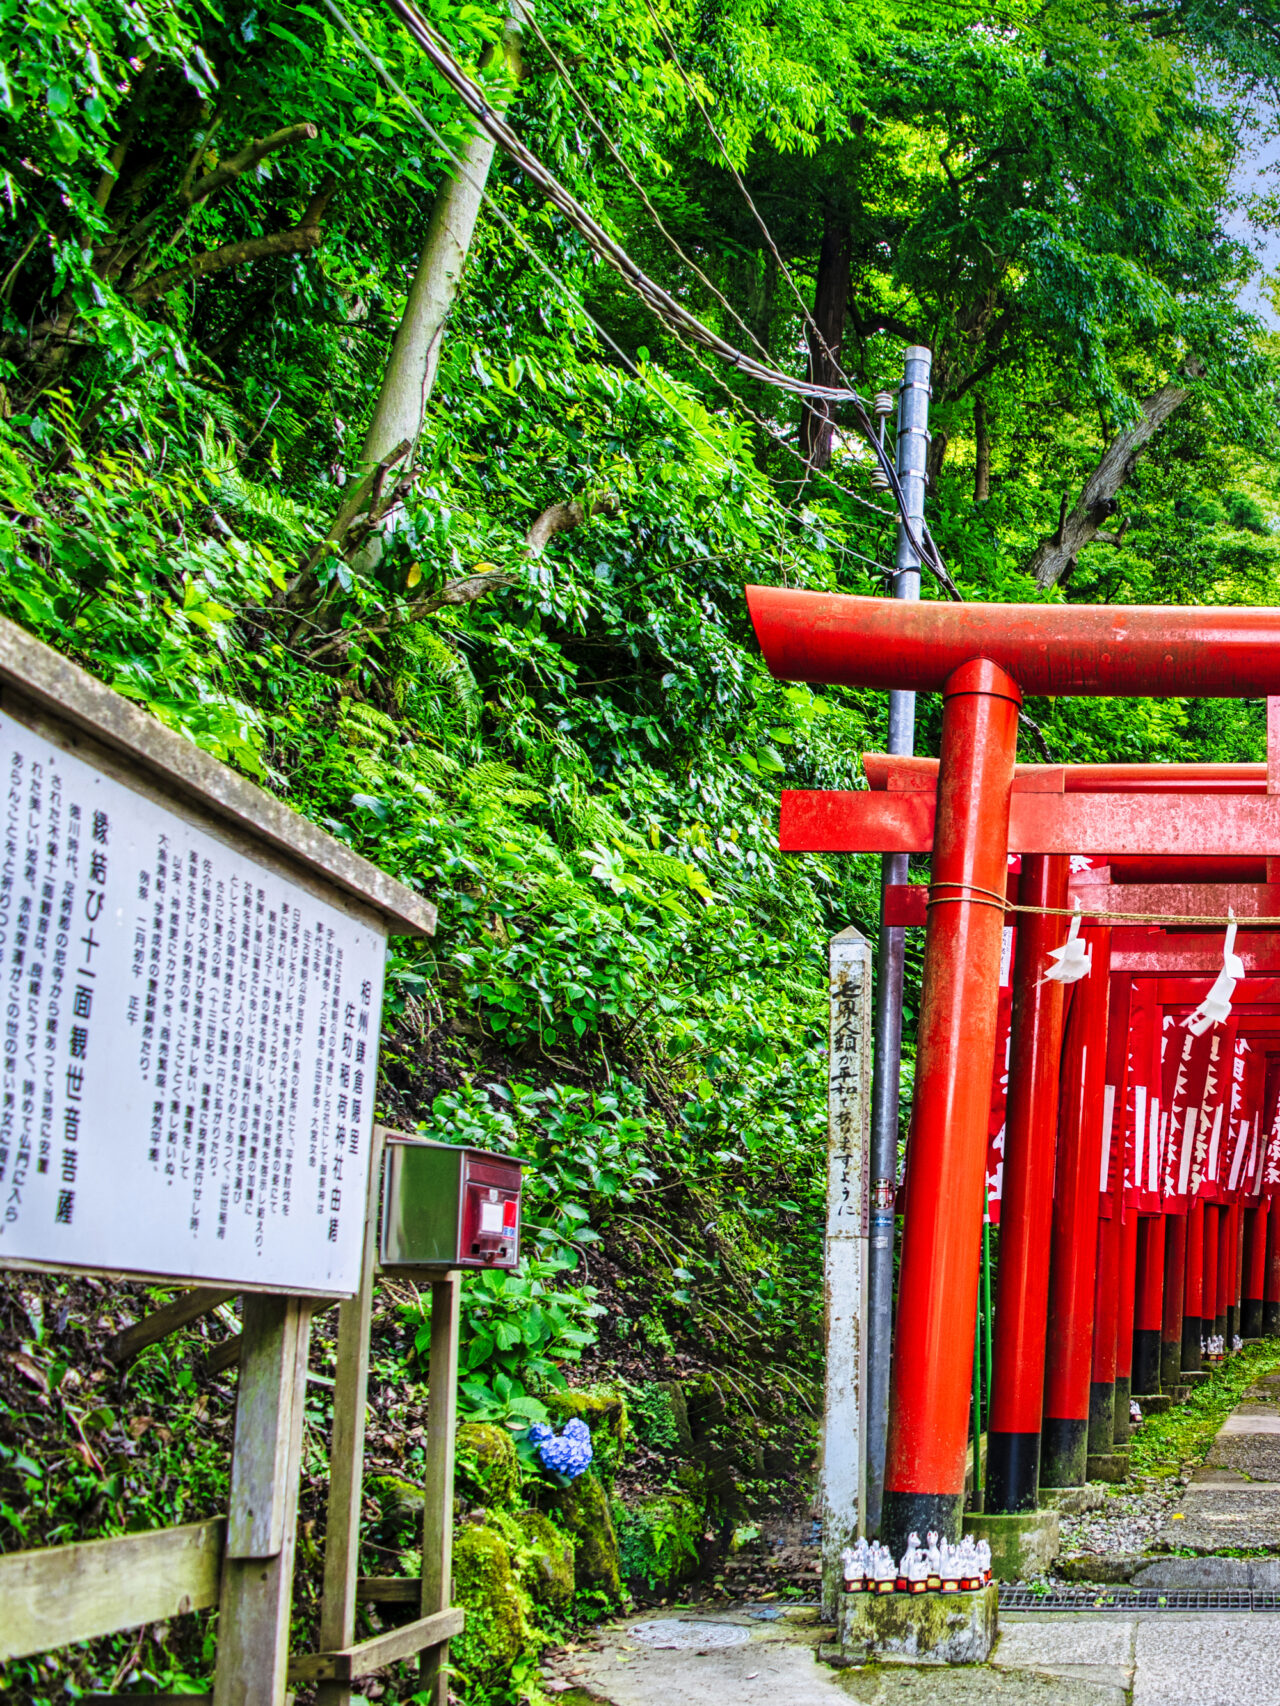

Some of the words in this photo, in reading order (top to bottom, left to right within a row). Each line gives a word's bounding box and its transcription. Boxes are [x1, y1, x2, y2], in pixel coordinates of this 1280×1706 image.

[131, 915, 146, 980] 二月初午
[137, 869, 149, 901] 例祭
[57, 812, 107, 1224] 縁結び十一面観世音菩薩
[126, 994, 138, 1026] 正午
[329, 1004, 354, 1242] 佐助稲荷神社由緒
[831, 981, 862, 1216] 世界人類が平和でありますように
